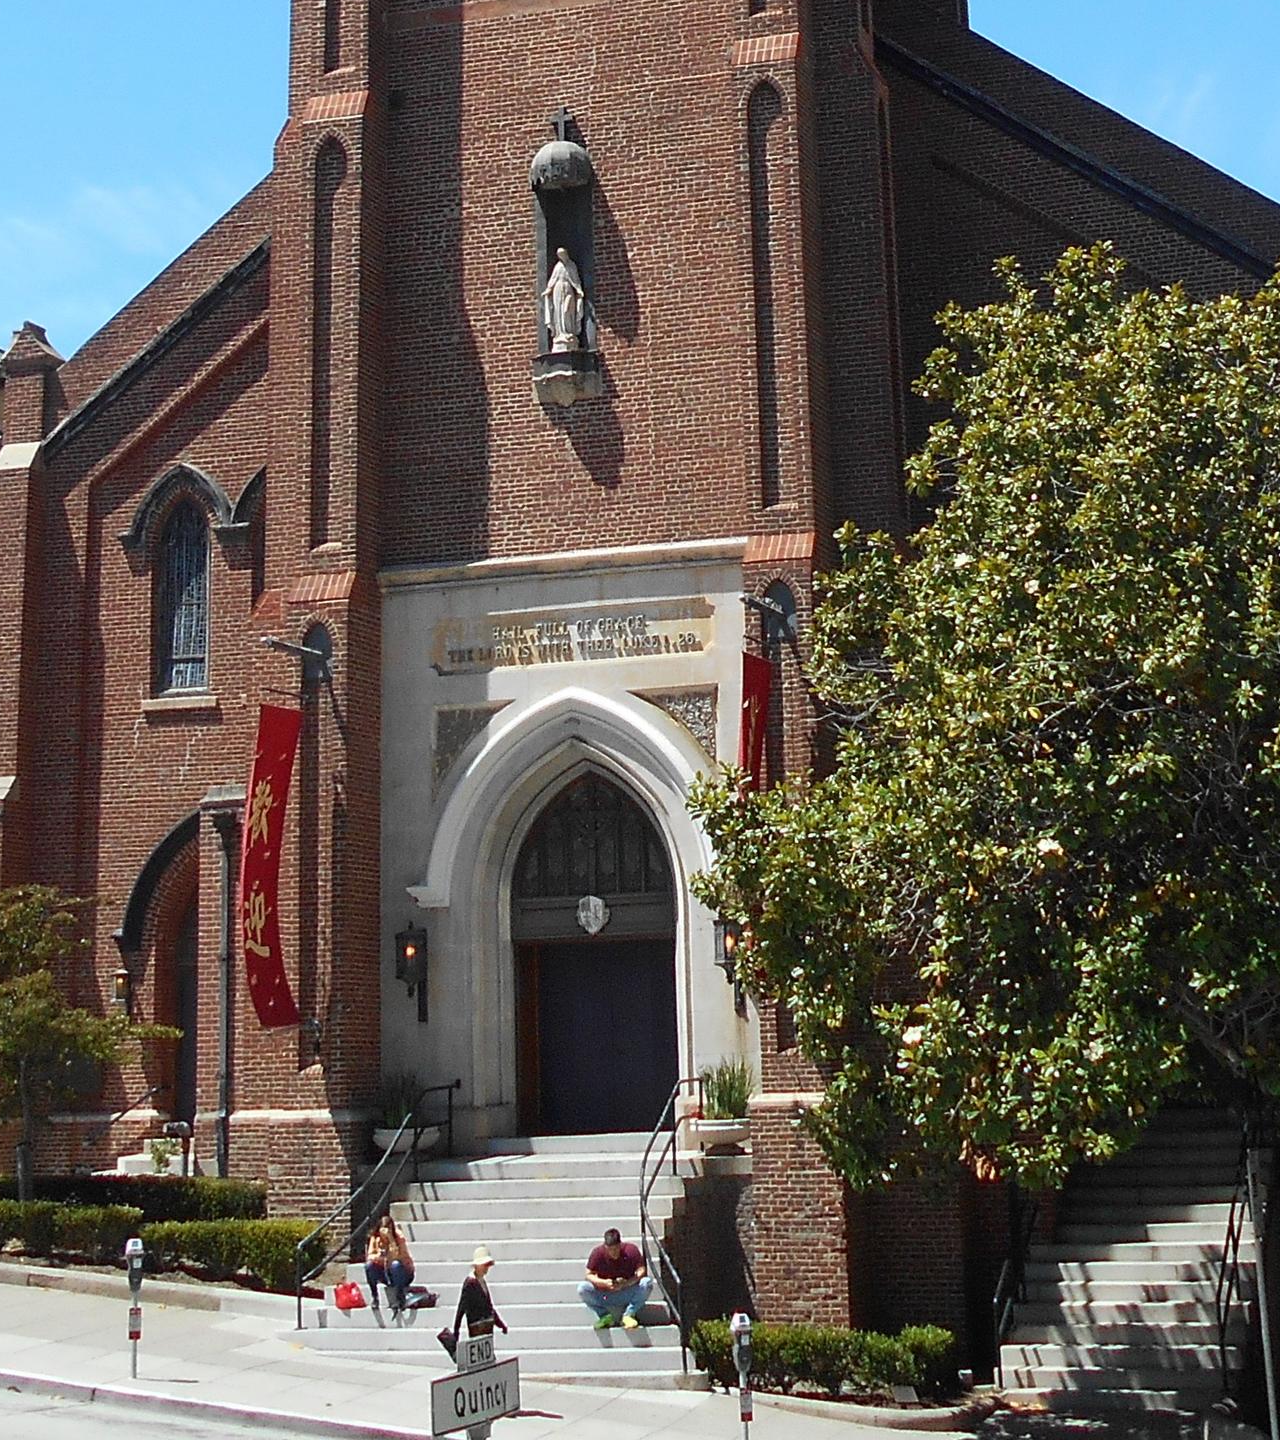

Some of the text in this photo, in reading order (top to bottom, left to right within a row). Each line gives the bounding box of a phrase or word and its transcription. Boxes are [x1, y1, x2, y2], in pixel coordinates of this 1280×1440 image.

[535, 621, 569, 637] FULL
[576, 619, 593, 635] OF
[468, 1340, 493, 1365] END
[454, 1380, 508, 1419] Quincy
